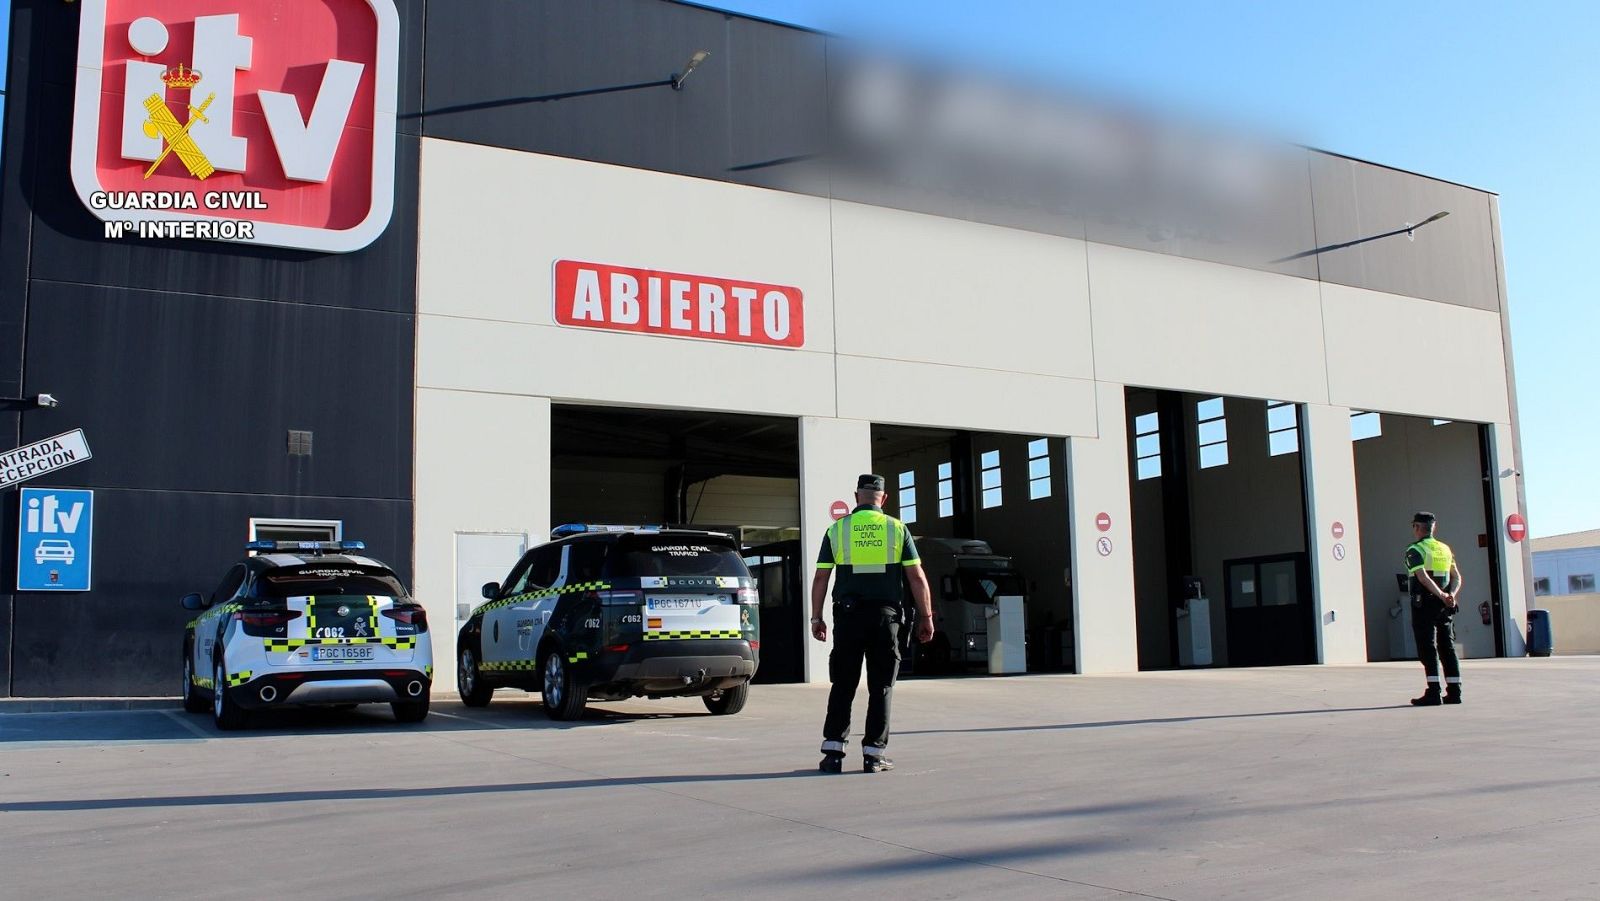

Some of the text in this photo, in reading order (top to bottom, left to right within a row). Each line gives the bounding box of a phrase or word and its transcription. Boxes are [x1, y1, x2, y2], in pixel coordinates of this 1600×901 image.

[121, 13, 365, 183] itv
[572, 268, 790, 341] ABIERTO
[0, 440, 63, 469] NTRADA
[0, 449, 75, 483] ECEPCION
[27, 494, 84, 533] itv
